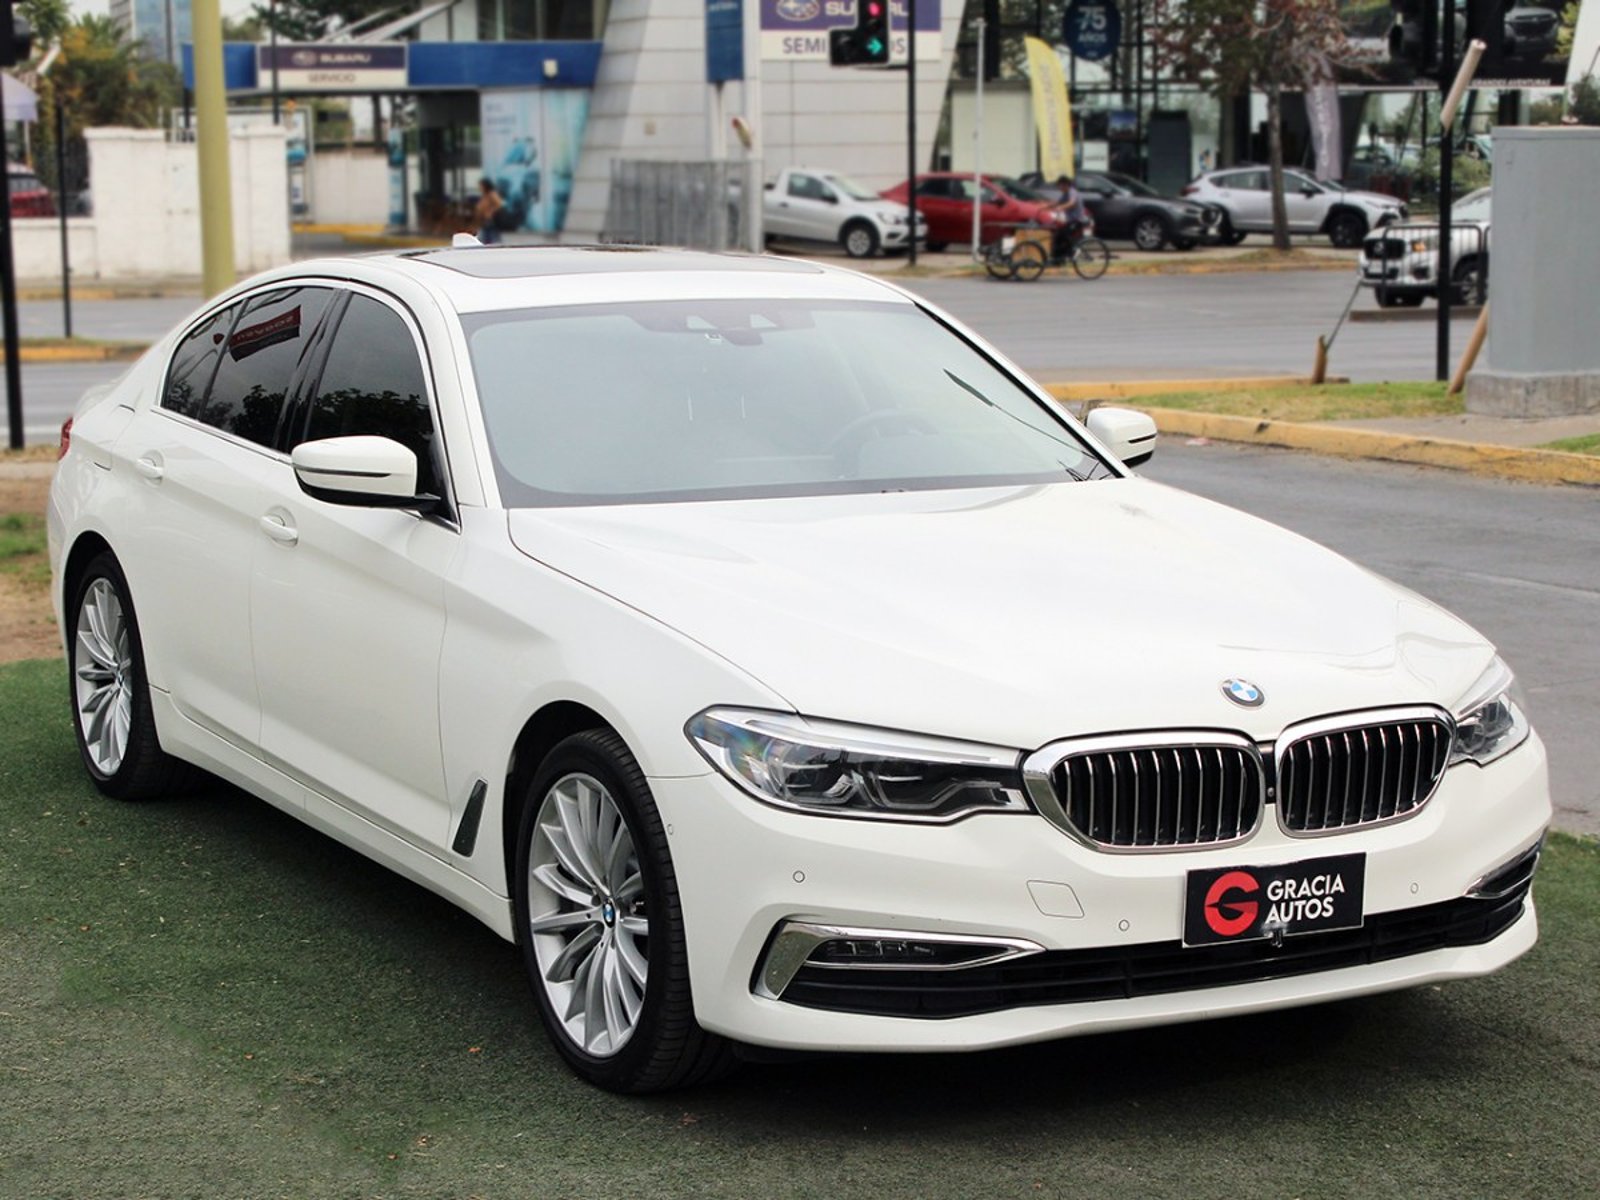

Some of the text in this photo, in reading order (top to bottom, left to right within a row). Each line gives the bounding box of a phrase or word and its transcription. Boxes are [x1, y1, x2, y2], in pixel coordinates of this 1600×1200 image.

[1078, 6, 1107, 30] 75
[319, 53, 372, 64] SUBARU
[307, 72, 357, 83] SERVICIO
[1266, 873, 1346, 901] GRACIA
[1264, 896, 1335, 926] AUTOS
